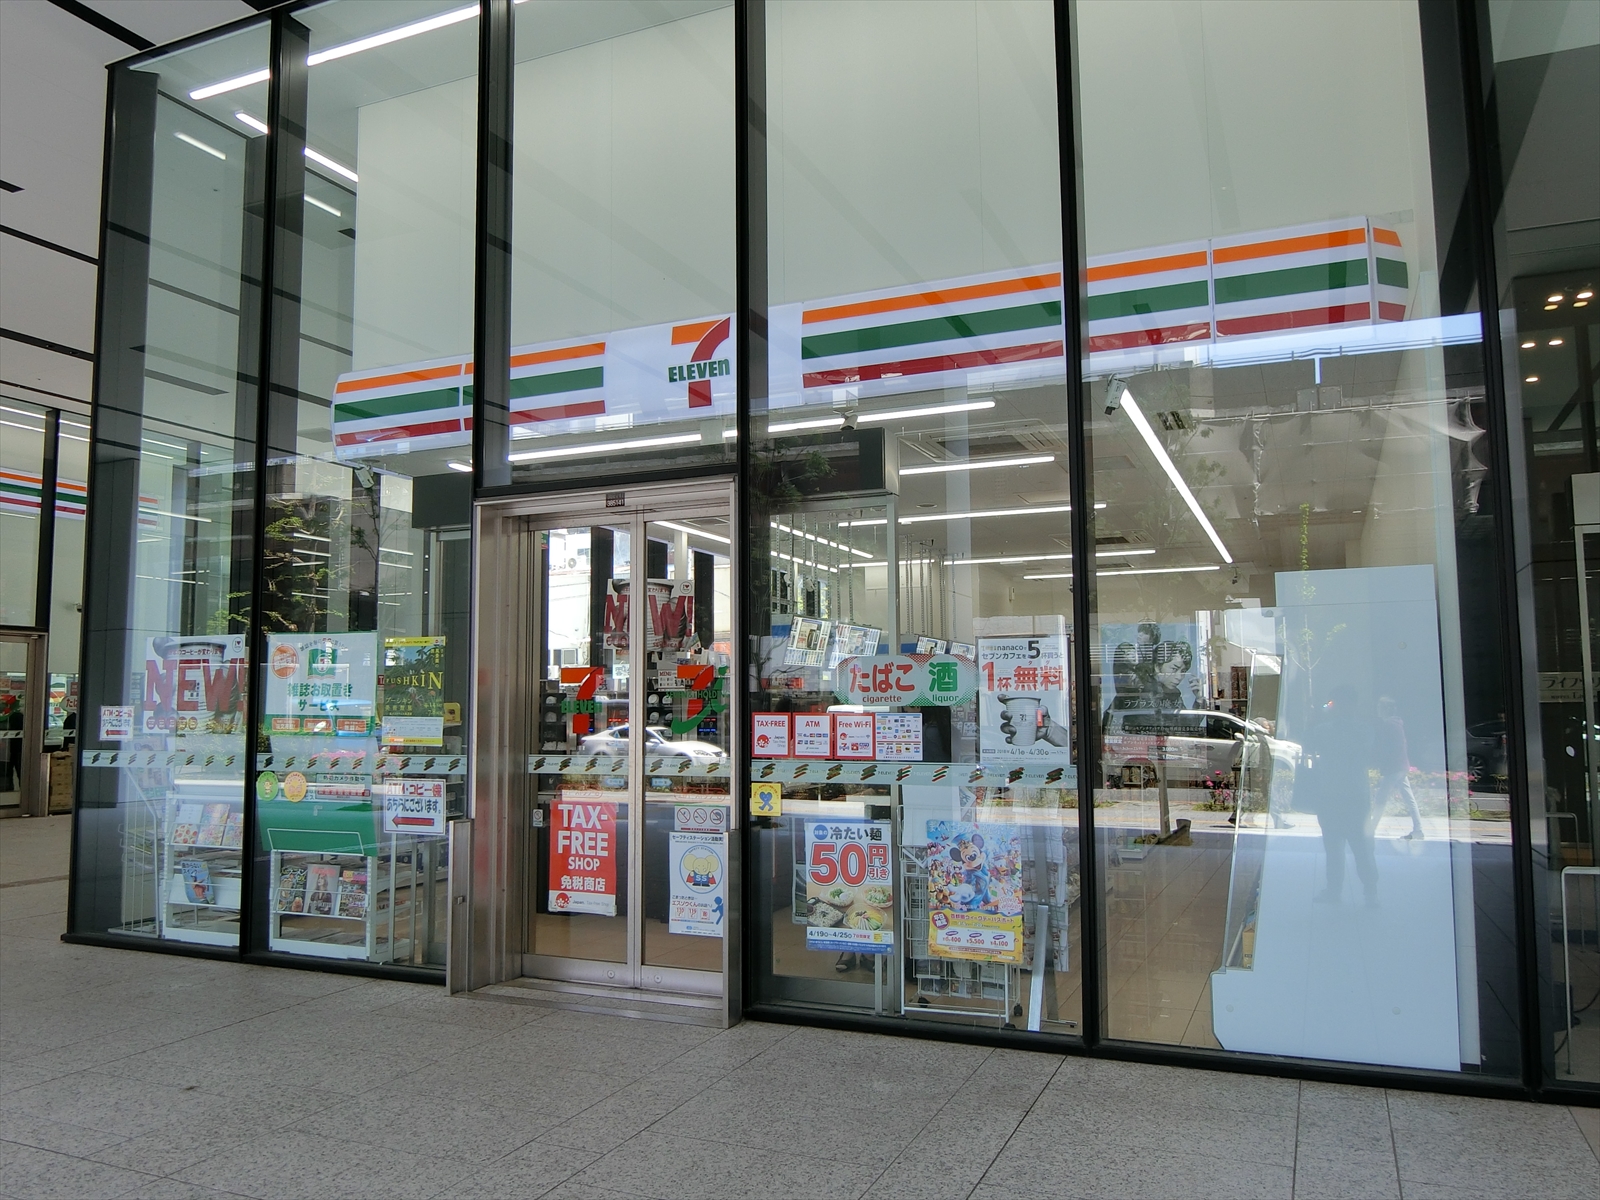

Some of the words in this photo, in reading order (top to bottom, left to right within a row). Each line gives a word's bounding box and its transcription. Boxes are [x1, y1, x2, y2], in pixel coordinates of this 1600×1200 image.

[604, 594, 694, 638] NW!
[143, 658, 245, 713] NEW!
[850, 661, 915, 693] たばこ
[929, 661, 957, 692] 酒
[982, 661, 1064, 691] 1杯無料
[287, 683, 353, 697] 雑誌お取置き
[862, 695, 902, 704] cigarette
[932, 694, 959, 702] liquor
[386, 782, 442, 797] ATM・コピー機
[558, 804, 608, 829] TAX-
[558, 830, 608, 856] FREE
[830, 826, 882, 841] 冷たい麺
[568, 856, 600, 871] SHOP
[808, 841, 868, 887] 50
[868, 867, 890, 880] 引き
[561, 875, 605, 891] 免税商店
